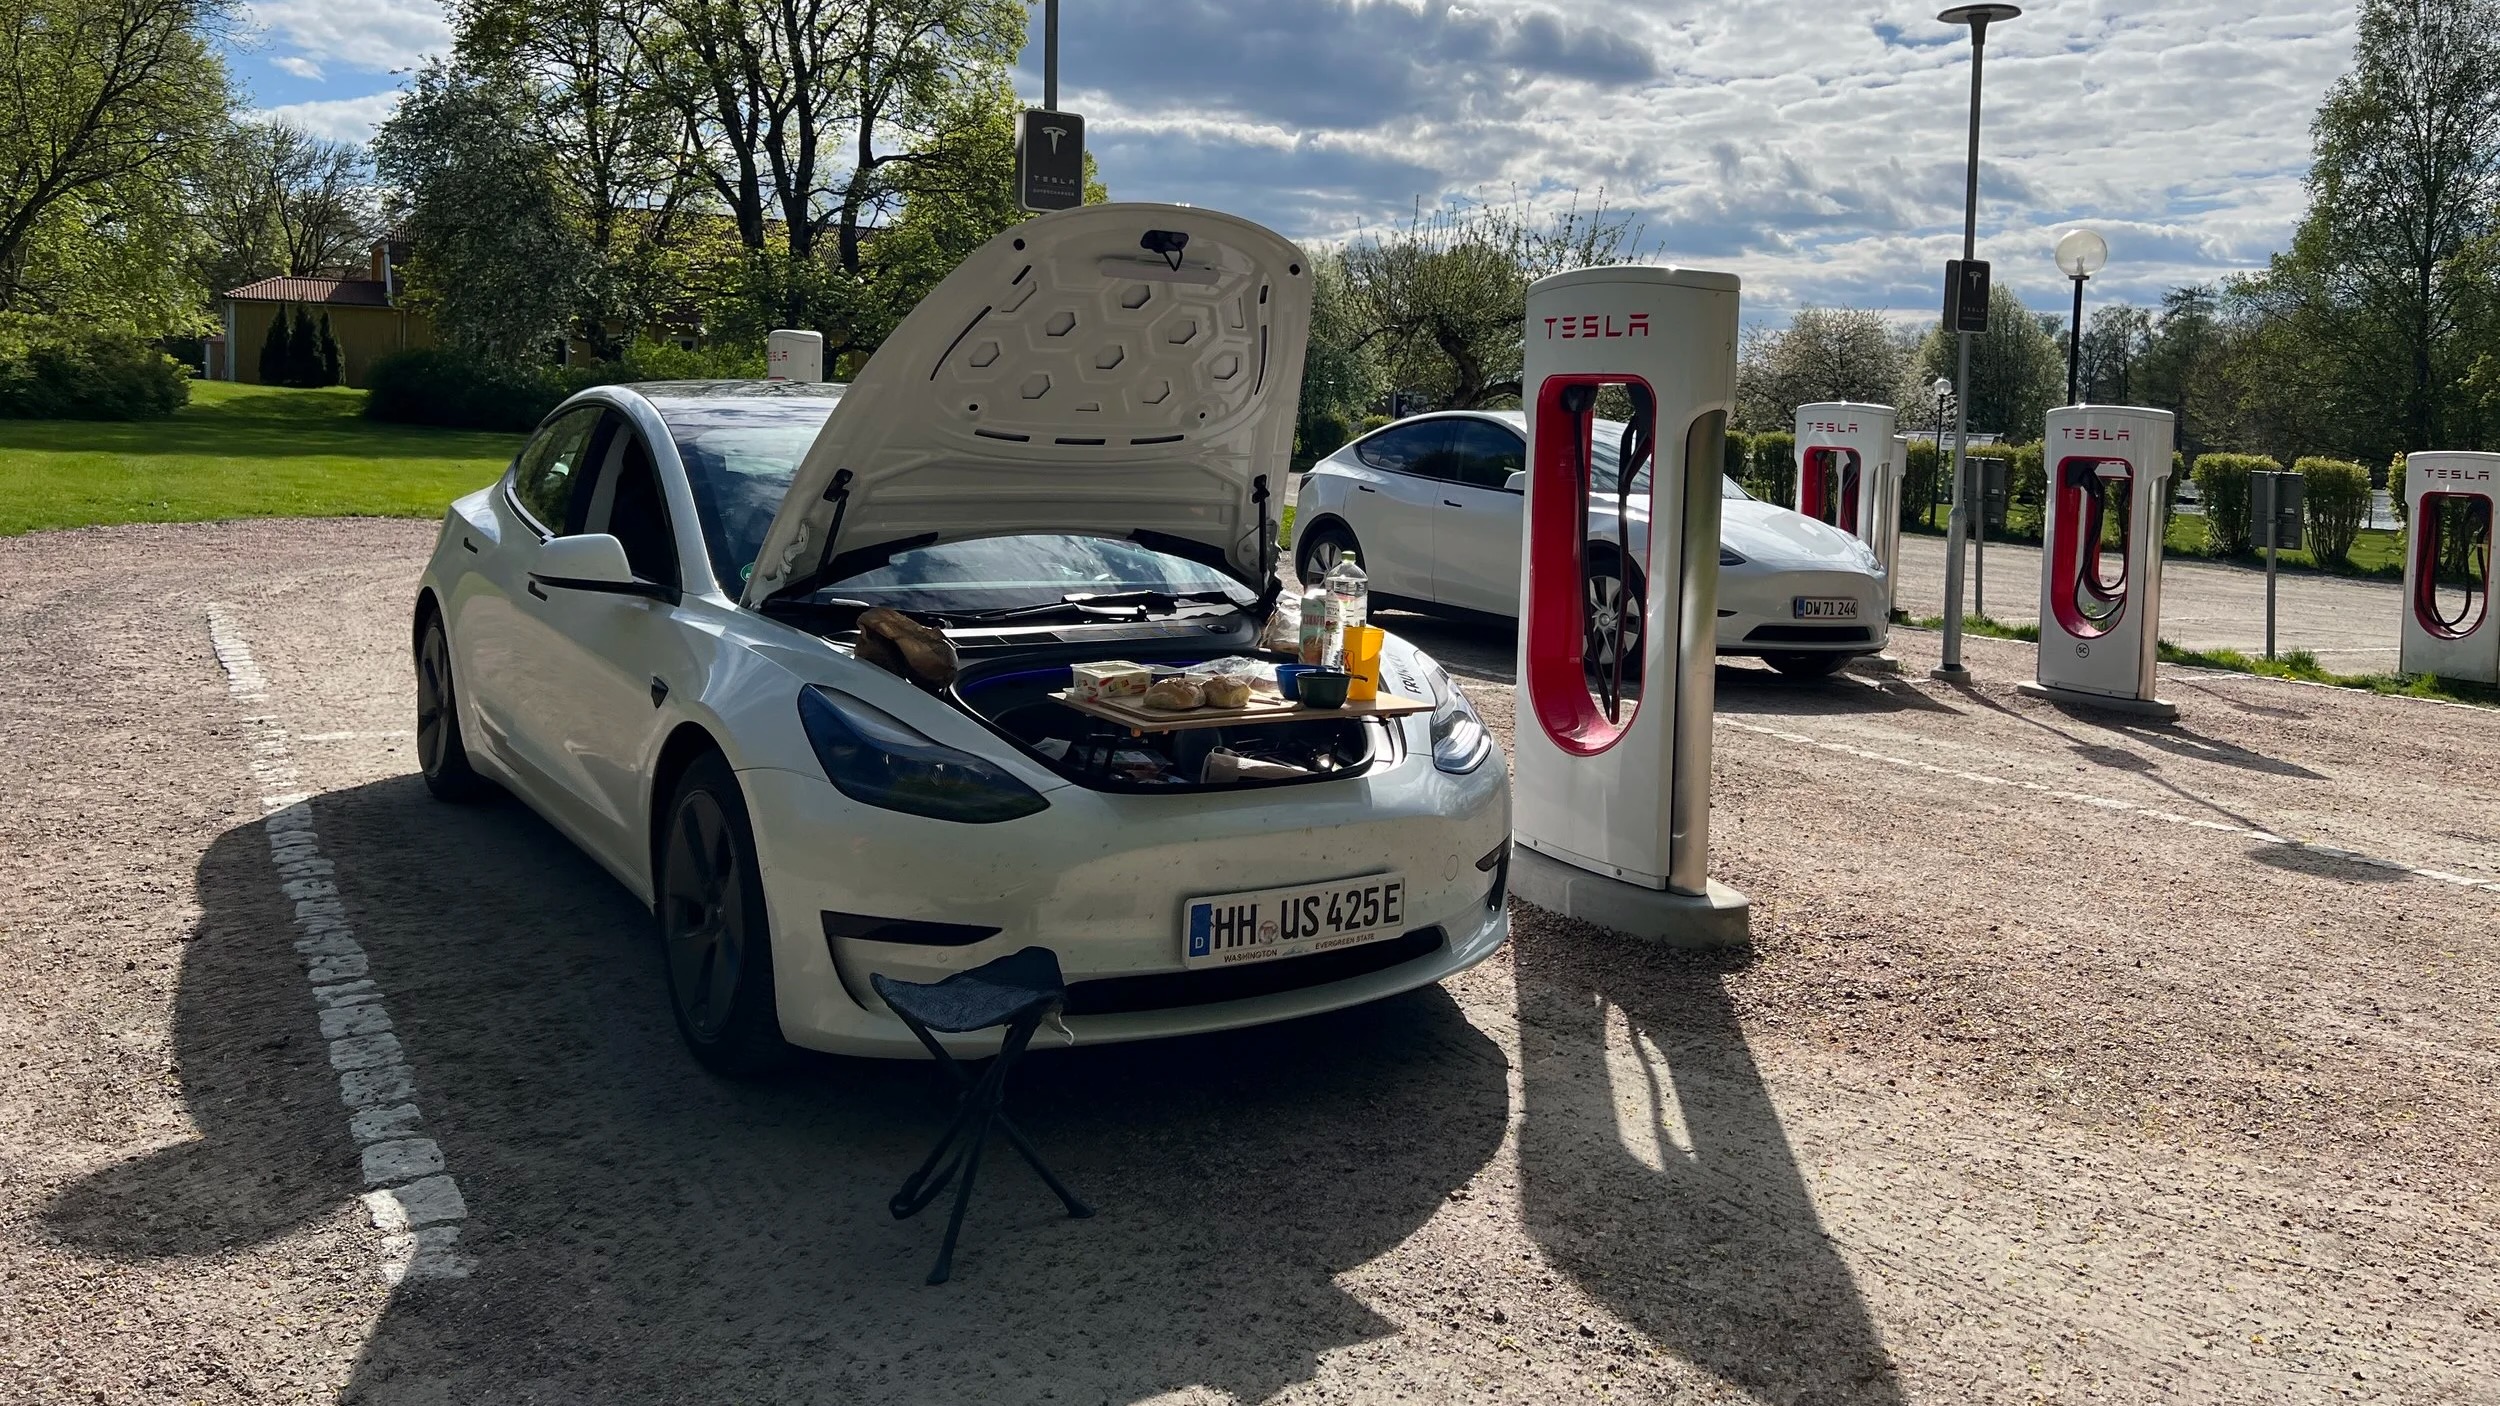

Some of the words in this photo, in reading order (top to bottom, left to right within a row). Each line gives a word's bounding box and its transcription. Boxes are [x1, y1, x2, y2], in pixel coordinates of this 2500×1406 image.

[1033, 175, 1075, 185] TESLA
[1543, 313, 1650, 340] TESLA
[1806, 422, 1858, 433] TESLA
[2062, 428, 2130, 441] TESLA
[2424, 468, 2490, 480] TESLA
[1805, 601, 1820, 615] DW
[1823, 601, 1834, 615] 71
[1838, 601, 1856, 616] 244
[1214, 903, 1257, 949] HH
[1280, 896, 1320, 940] US
[1326, 883, 1401, 932] 425E
[1195, 936, 1204, 949] D
[1315, 935, 1356, 950] EVERGREEN
[1356, 933, 1375, 943] STATE
[1223, 949, 1278, 963] WASHINGTON
